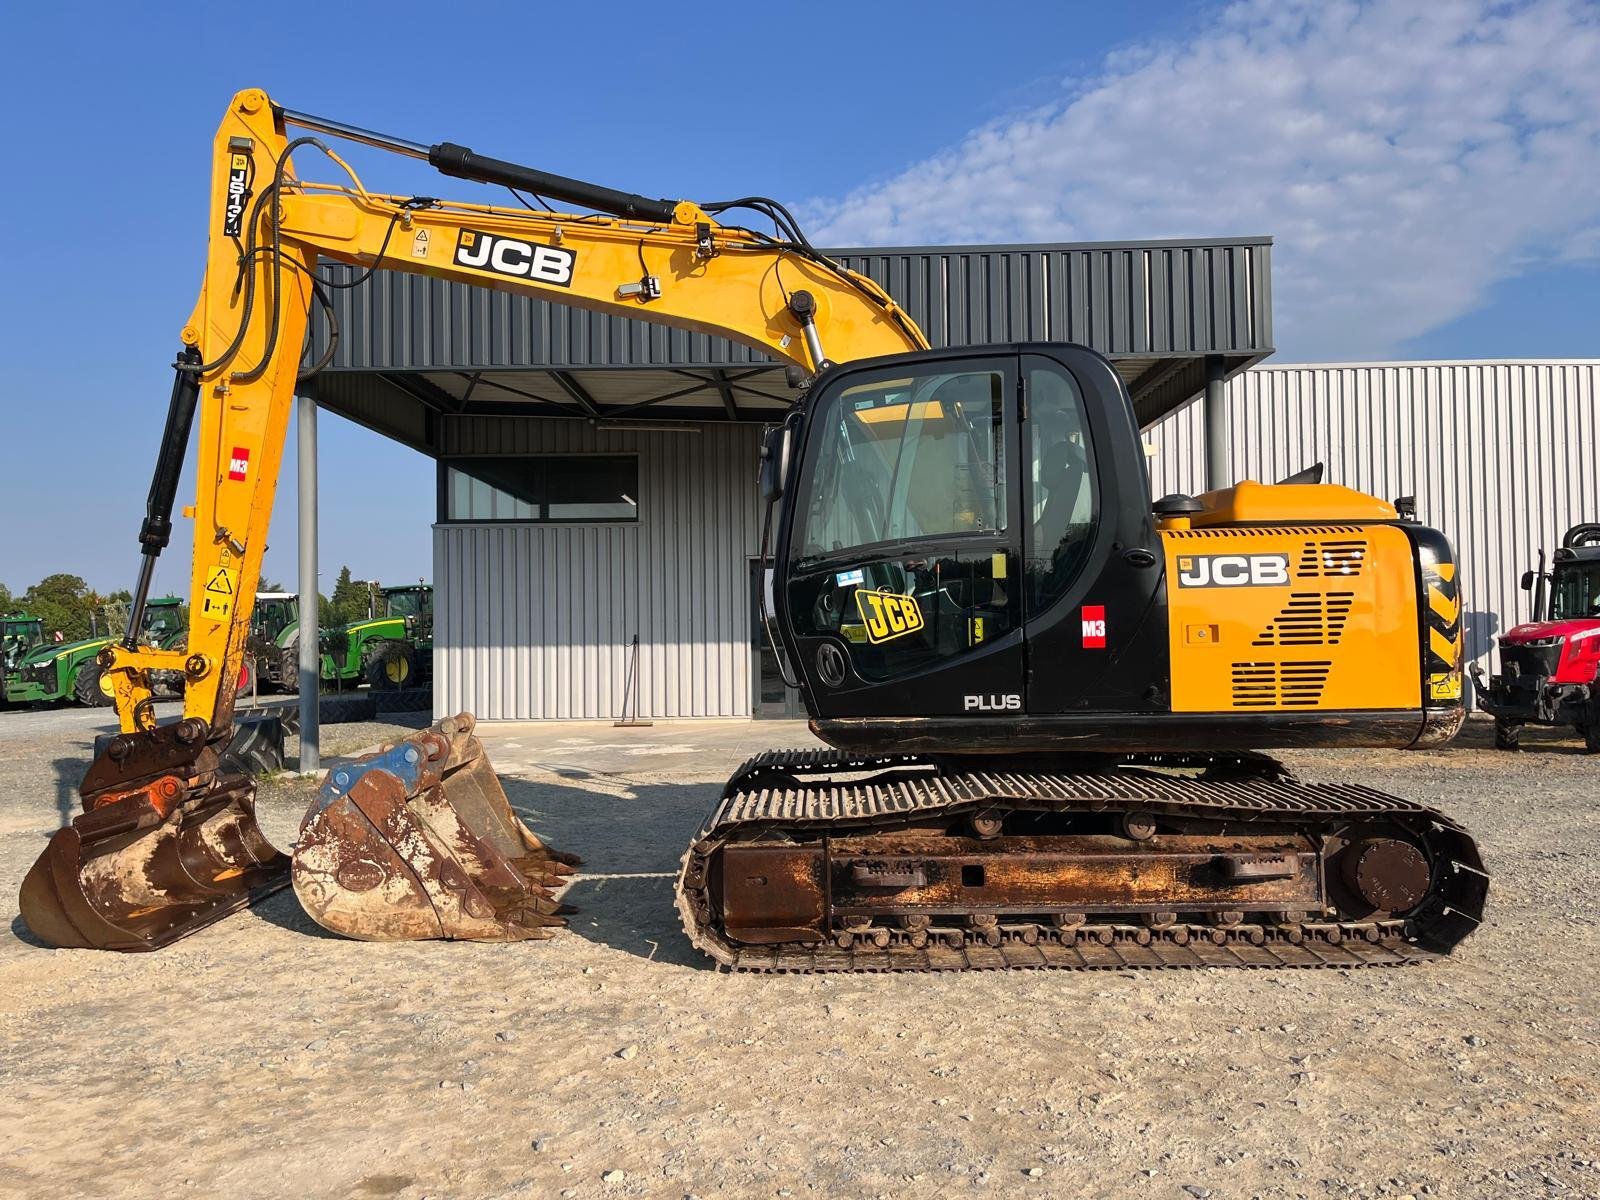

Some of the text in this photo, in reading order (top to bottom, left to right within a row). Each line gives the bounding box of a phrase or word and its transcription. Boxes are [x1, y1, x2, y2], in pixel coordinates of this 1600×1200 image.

[457, 235, 572, 284] JCB
[229, 458, 249, 474] M3
[1180, 556, 1289, 586] JCB
[867, 595, 919, 638] JCB
[1082, 620, 1106, 637] M3
[964, 694, 1021, 711] PLUS
